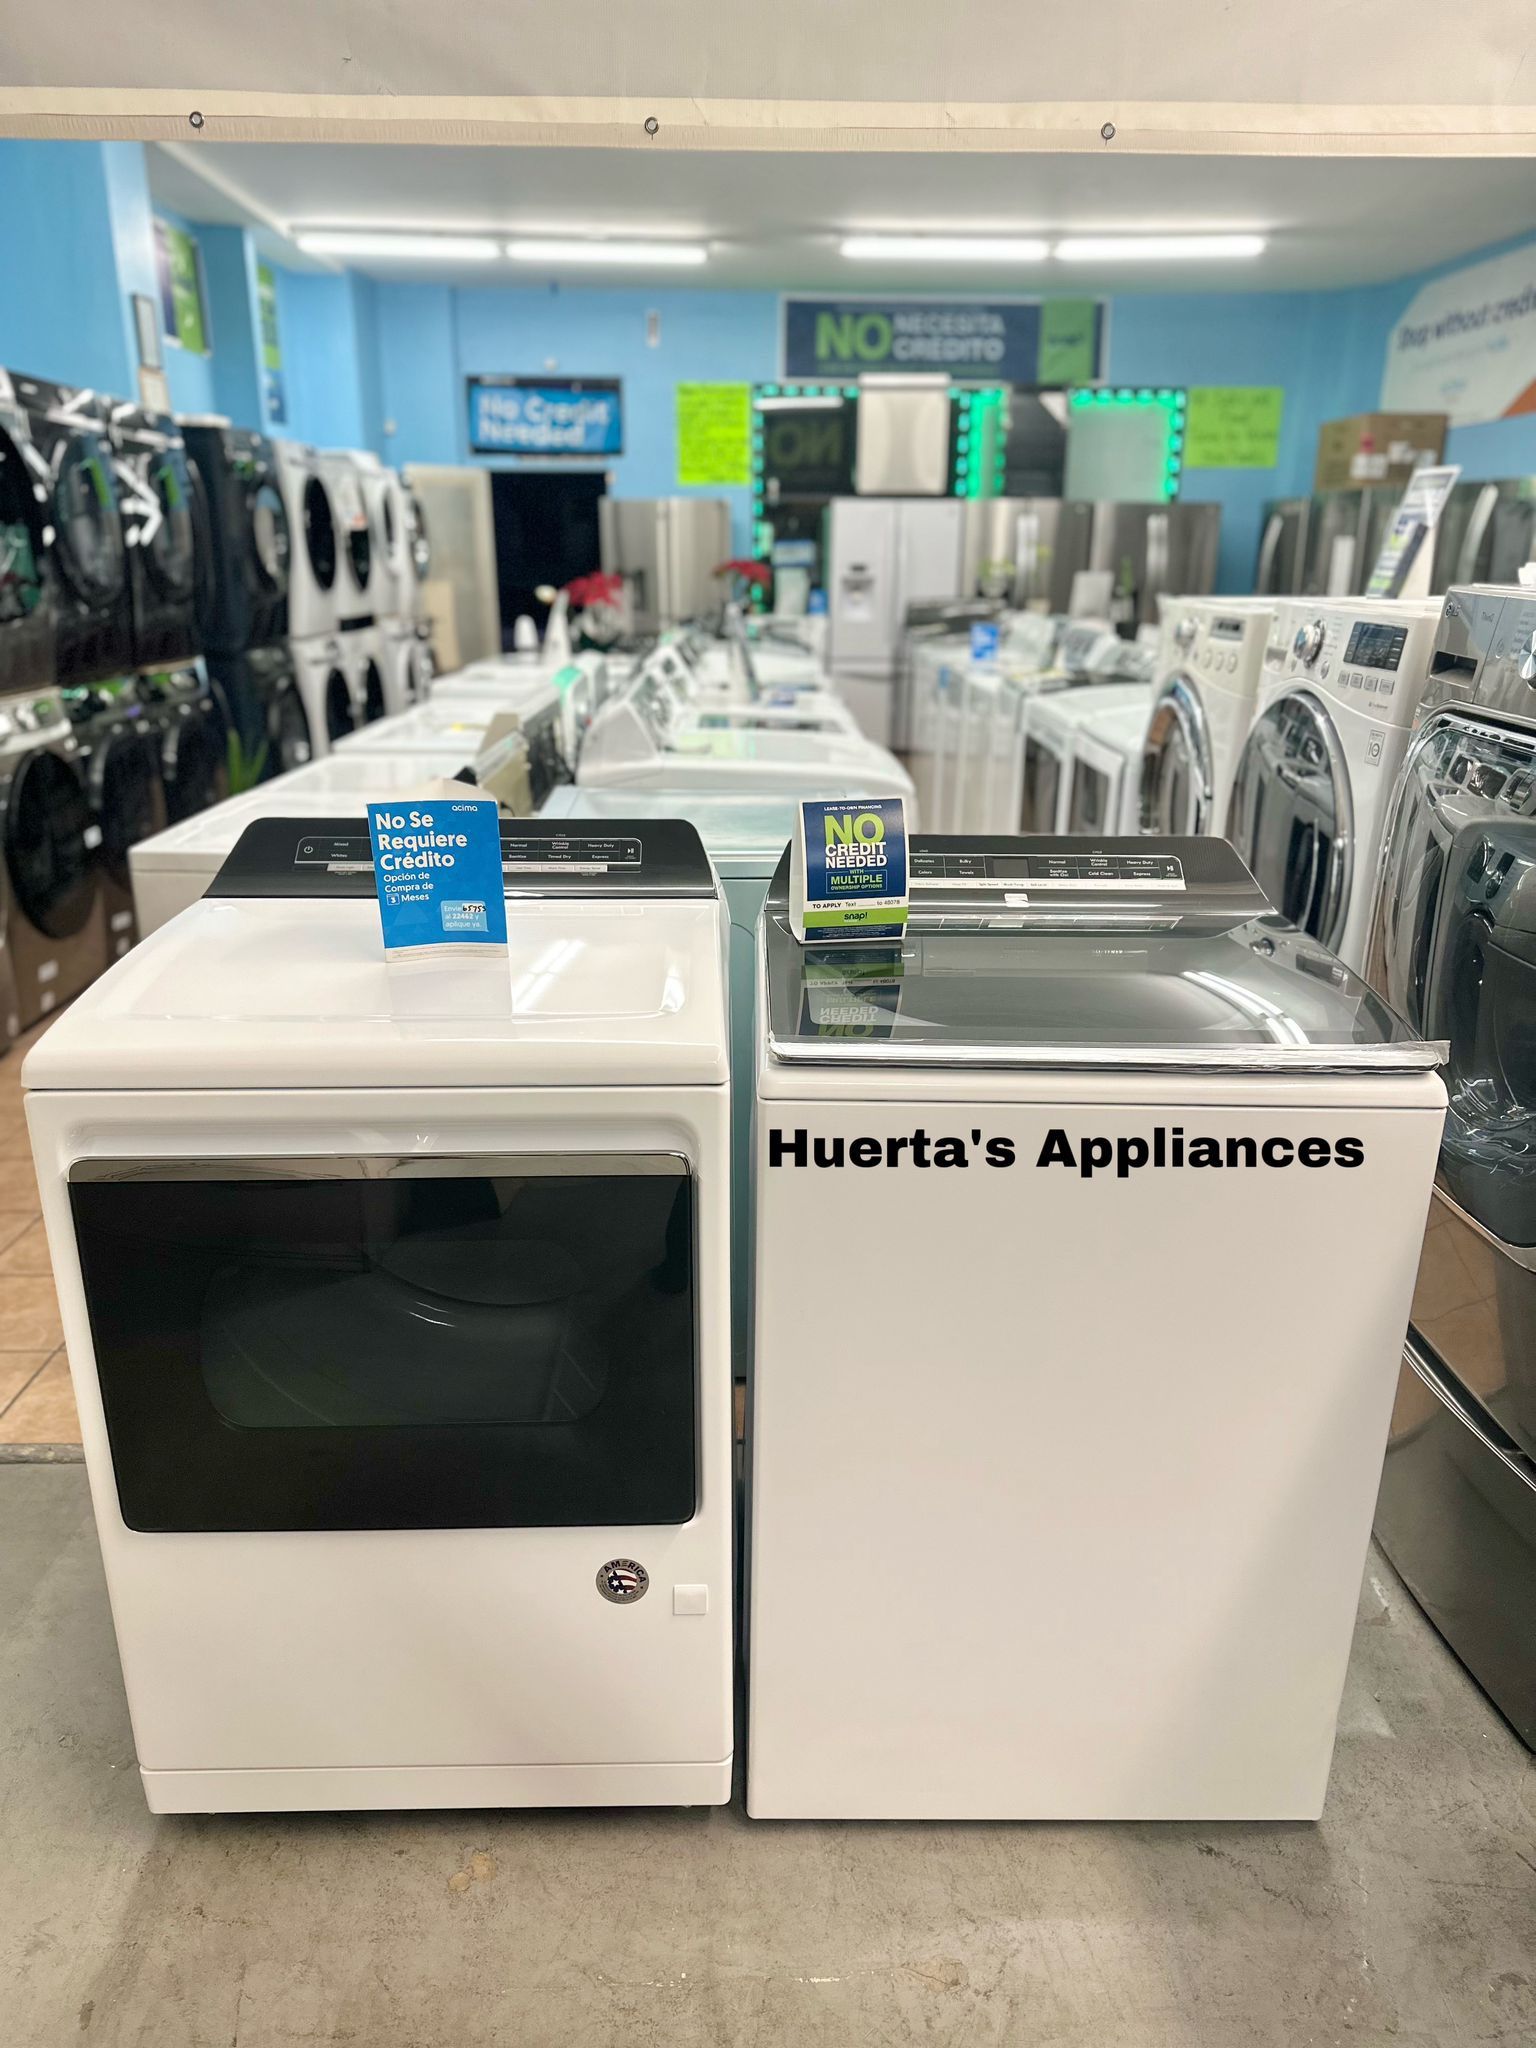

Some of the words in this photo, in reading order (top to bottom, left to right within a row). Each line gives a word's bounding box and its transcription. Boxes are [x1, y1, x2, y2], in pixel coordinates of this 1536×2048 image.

[815, 313, 892, 360] NO
[893, 313, 1005, 335] NECESITA
[479, 394, 520, 421] No
[524, 394, 609, 423] Credit
[479, 420, 585, 447] Needed
[452, 804, 478, 812] acima
[375, 813, 406, 830] No
[409, 811, 434, 828] Se
[824, 813, 885, 846] NO
[378, 831, 468, 852] Requiere
[825, 842, 886, 857] CREDIT
[380, 851, 455, 871] Crédito
[826, 855, 887, 869] NEEDED
[384, 872, 416, 883] Opción
[418, 872, 430, 880] de
[831, 874, 883, 885] MULTIPLE
[385, 884, 420, 894] Compra
[422, 882, 434, 890] de
[401, 893, 429, 902] Meses
[844, 911, 868, 920] snap!
[445, 920, 470, 928] aplique
[603, 1560, 647, 1583] AMERICA
